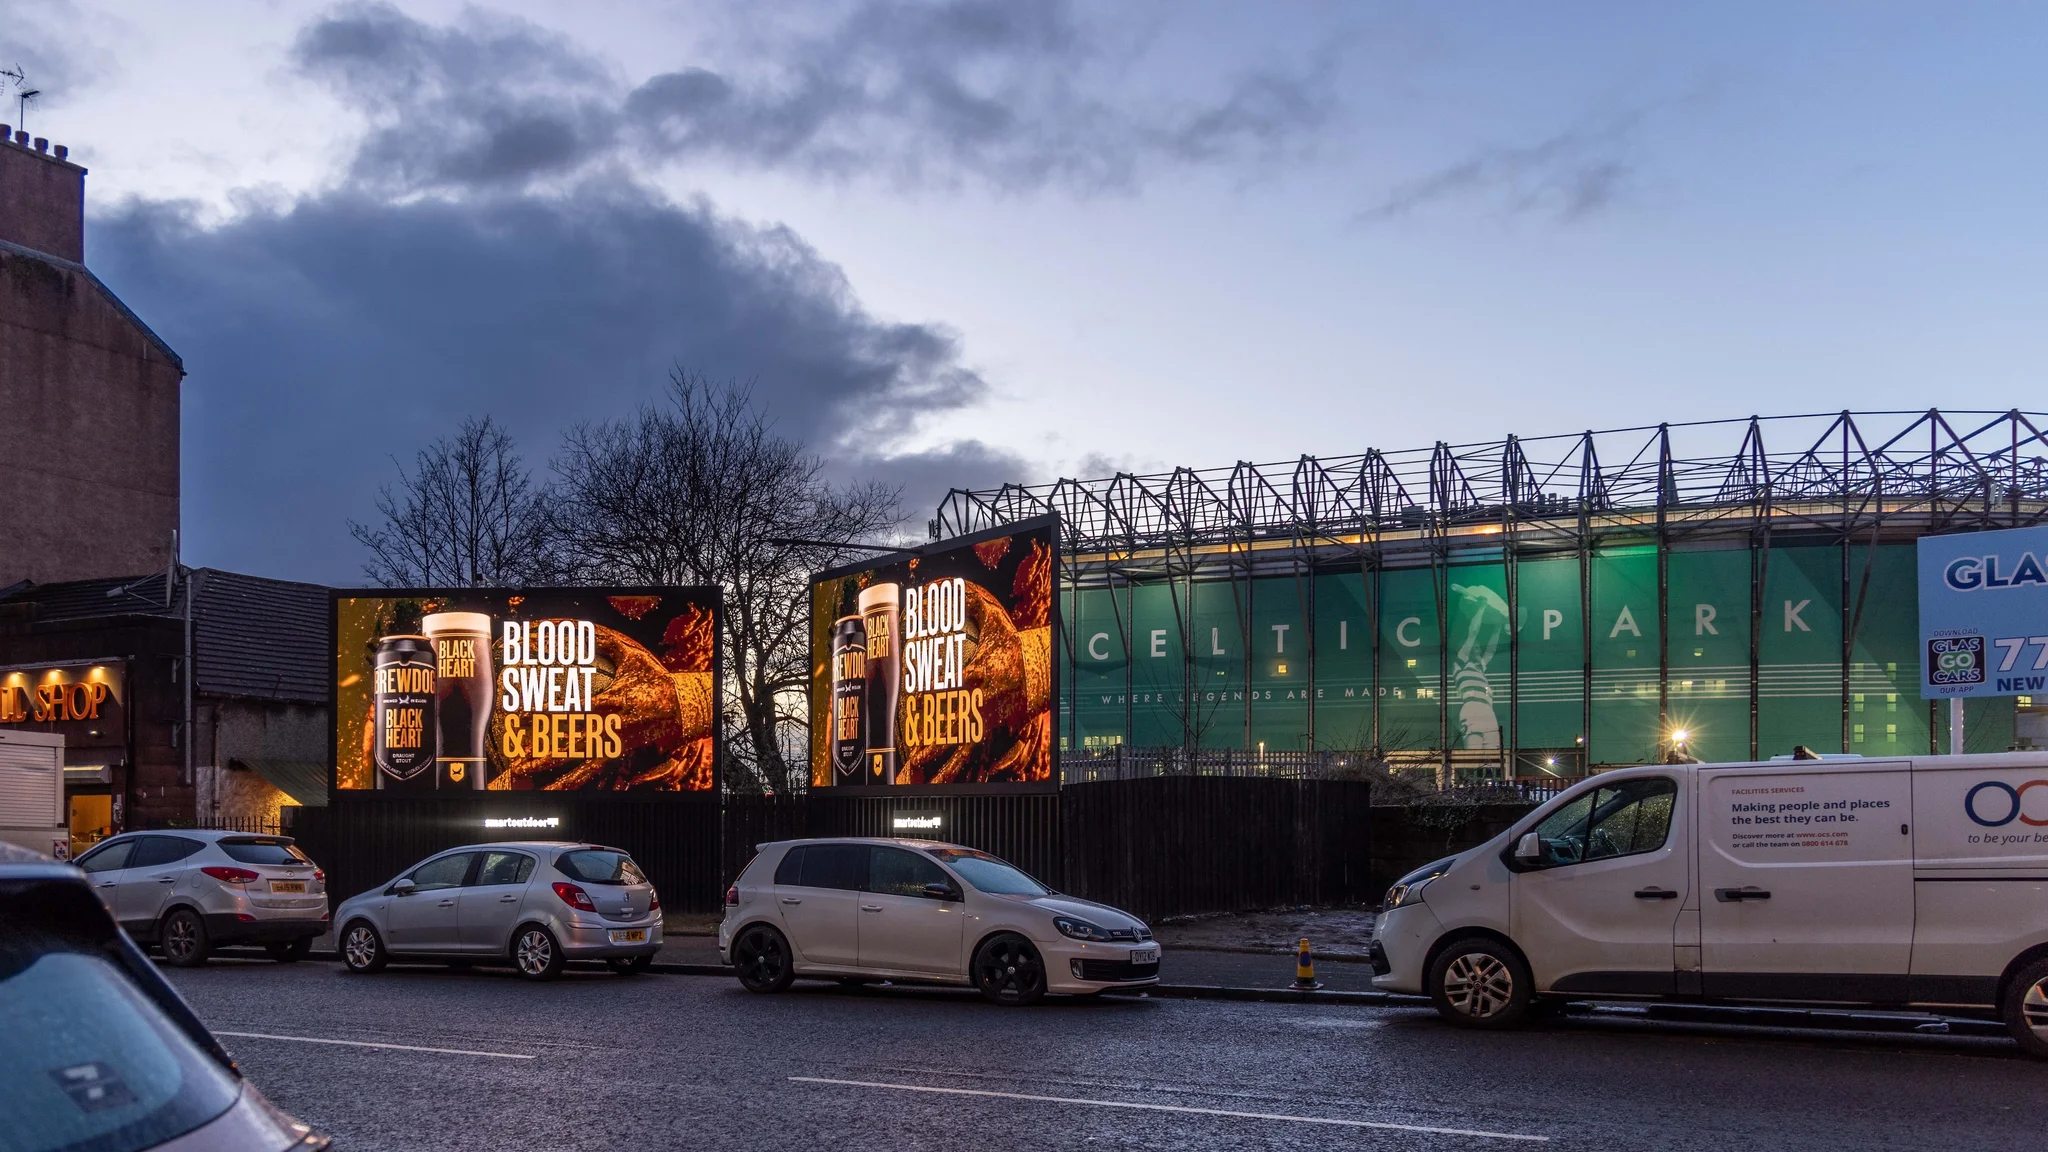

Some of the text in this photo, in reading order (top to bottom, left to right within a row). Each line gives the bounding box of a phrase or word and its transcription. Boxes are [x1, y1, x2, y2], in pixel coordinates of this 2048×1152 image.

[1944, 551, 2048, 592] GLA
[906, 577, 966, 640] BLOOD
[868, 614, 889, 638] BLACK
[1088, 599, 1812, 660] CELTIC PARK
[1933, 628, 1978, 637] DOWNLOAD
[438, 640, 474, 660] BLACK
[503, 620, 595, 665] BLOOD
[867, 635, 889, 660] HEART
[1932, 638, 1980, 654] GLAS
[438, 659, 475, 678] HEART
[905, 633, 966, 693] SWEAT
[1939, 653, 1973, 668] GO
[374, 668, 436, 695] BREWDOG
[1933, 668, 1981, 683] CARS
[1997, 676, 2045, 692] NEW
[502, 667, 596, 712] SWEAT
[1101, 687, 1400, 704] WHERE LEGENDS ARE MADE
[34, 682, 107, 722] SHOP
[838, 696, 859, 718] BLACK
[386, 709, 423, 728] BLACK
[906, 687, 984, 747] & BEERS
[386, 729, 423, 748] HEART
[503, 713, 622, 759] & BEERS
[838, 717, 859, 741] HEART
[1732, 799, 1890, 813] Making people and places
[1732, 813, 1859, 826] the best they can be.
[1732, 832, 1763, 840] Discover
[1968, 832, 2048, 846] to be your be
